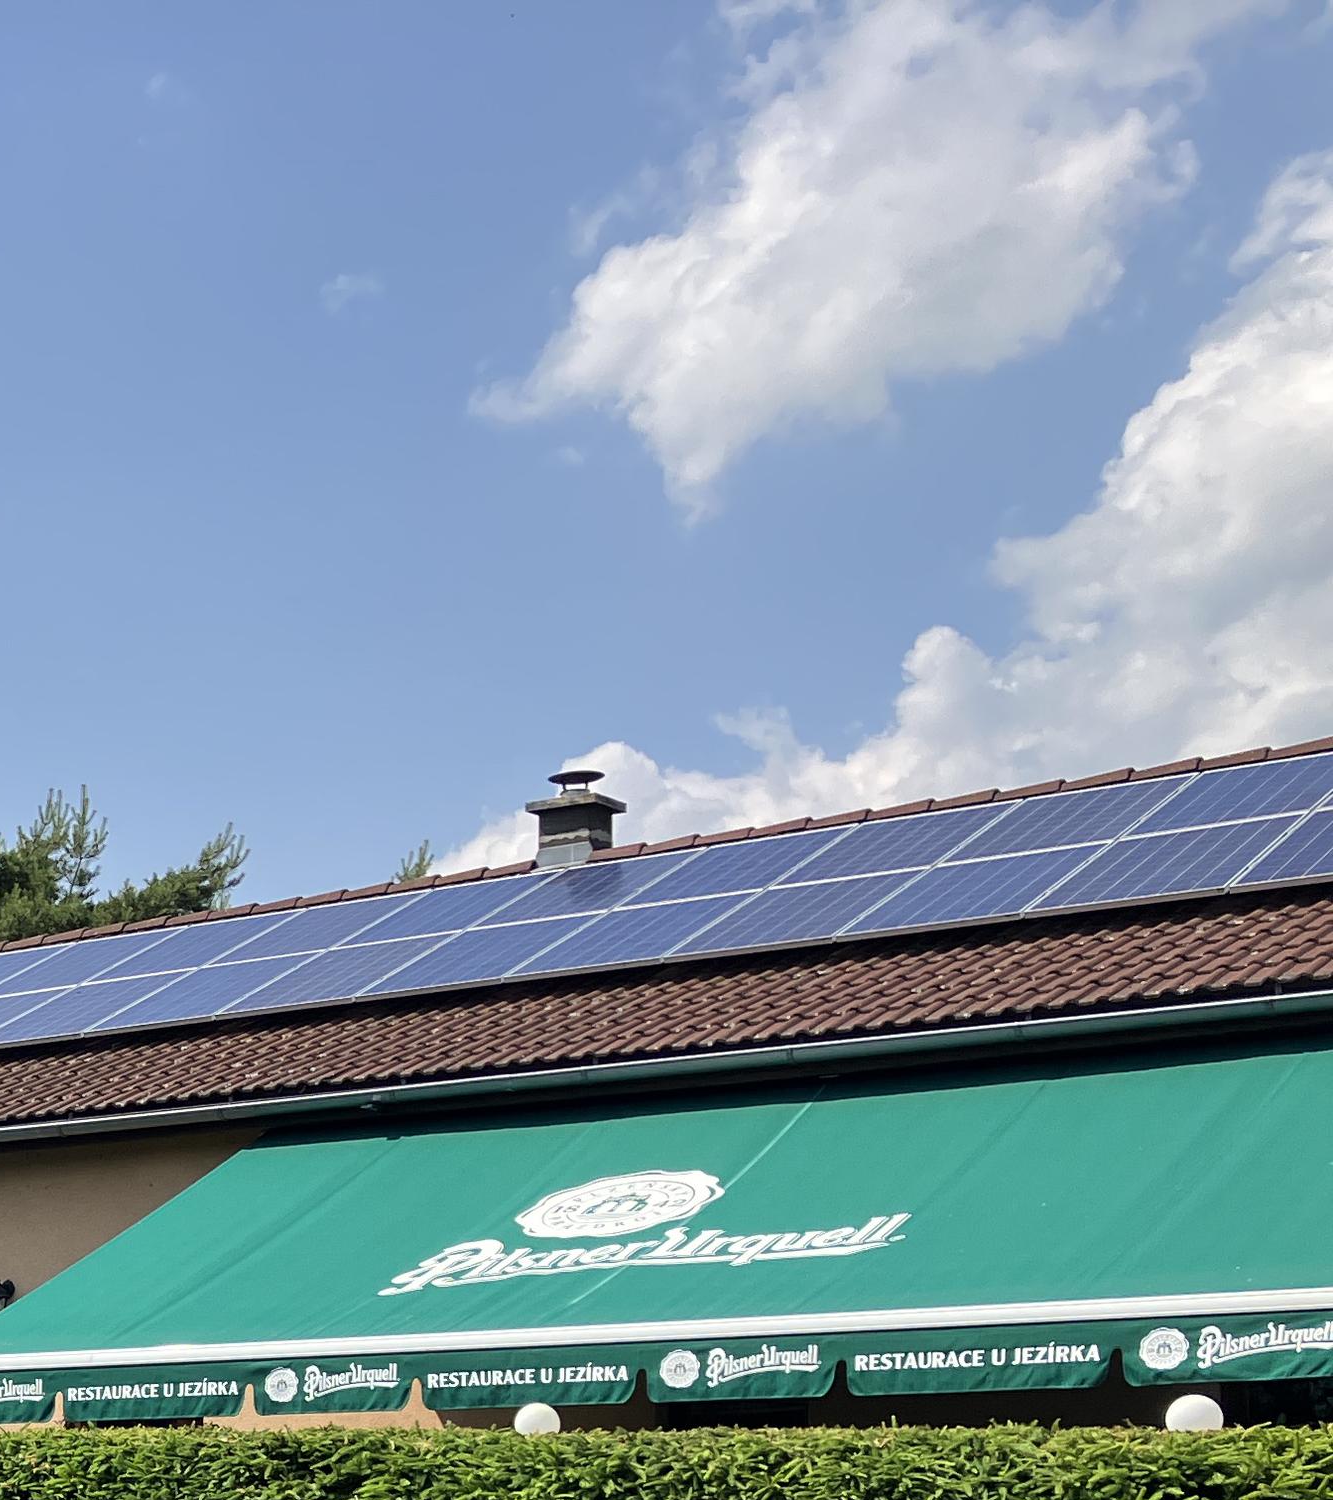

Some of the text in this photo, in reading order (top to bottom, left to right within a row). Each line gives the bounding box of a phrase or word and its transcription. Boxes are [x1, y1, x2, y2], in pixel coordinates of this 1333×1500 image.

[378, 1239, 661, 1295] Pilsner
[854, 1341, 1101, 1371] RESTAURACE U JEZÍRKA
[1196, 1325, 1270, 1369] Pilsner
[303, 1364, 353, 1402] Pilsner
[427, 1361, 629, 1389] RESTAURACE U JEZÍRKA
[705, 1347, 765, 1389] Pilsner
[67, 1377, 239, 1402] RESTAURACE U JEZÍRKA
